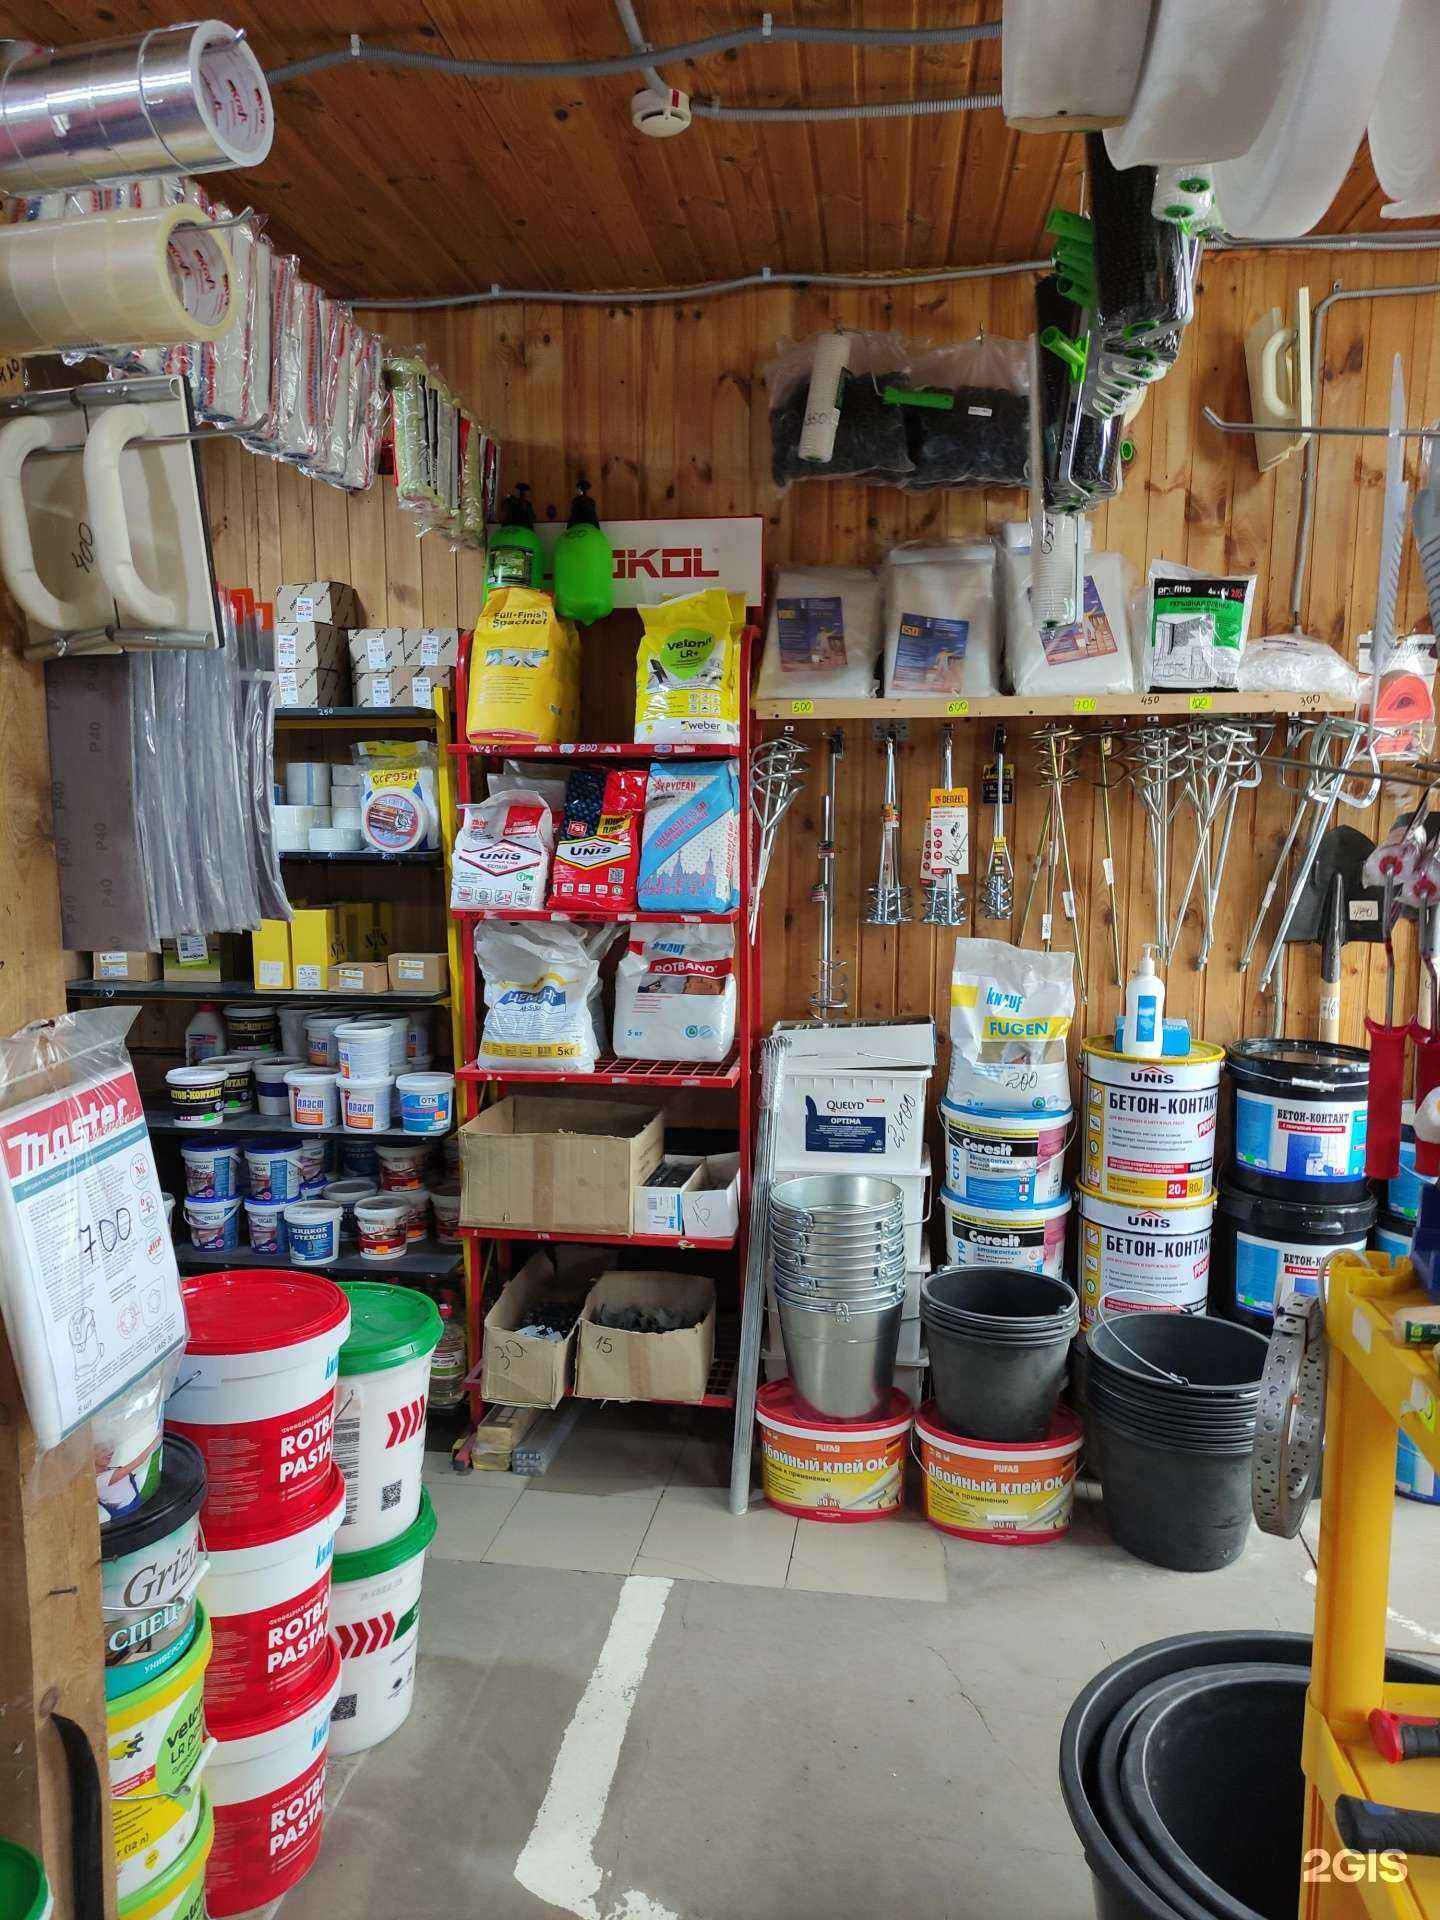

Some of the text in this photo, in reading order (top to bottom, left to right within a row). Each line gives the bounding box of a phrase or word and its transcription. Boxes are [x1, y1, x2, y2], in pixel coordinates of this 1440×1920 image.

[493, 619, 548, 628] Spachtel
[1141, 695, 1160, 705] 450
[793, 702, 812, 712] 500
[689, 720, 721, 731] weber
[479, 851, 522, 862] UNIS
[569, 846, 612, 856] UNIS
[654, 960, 716, 973] ROTBAND
[989, 1022, 1049, 1036] FUGEN
[1130, 1072, 1174, 1084] UNIS
[826, 1100, 864, 1111] QUELYD
[830, 1117, 862, 1125] OPTIMA
[1277, 1108, 1350, 1124] БЕТОН-КОНТАКТ
[962, 1137, 1013, 1156] Ceresit
[1168, 1184, 1181, 1195] 20
[1128, 1216, 1171, 1228] UNIS
[968, 1230, 1021, 1247] Ceresit
[595, 1335, 613, 1354] 15
[823, 1459, 865, 1474] клей
[928, 1461, 998, 1493] Обойный
[1000, 1481, 1042, 1495] клей
